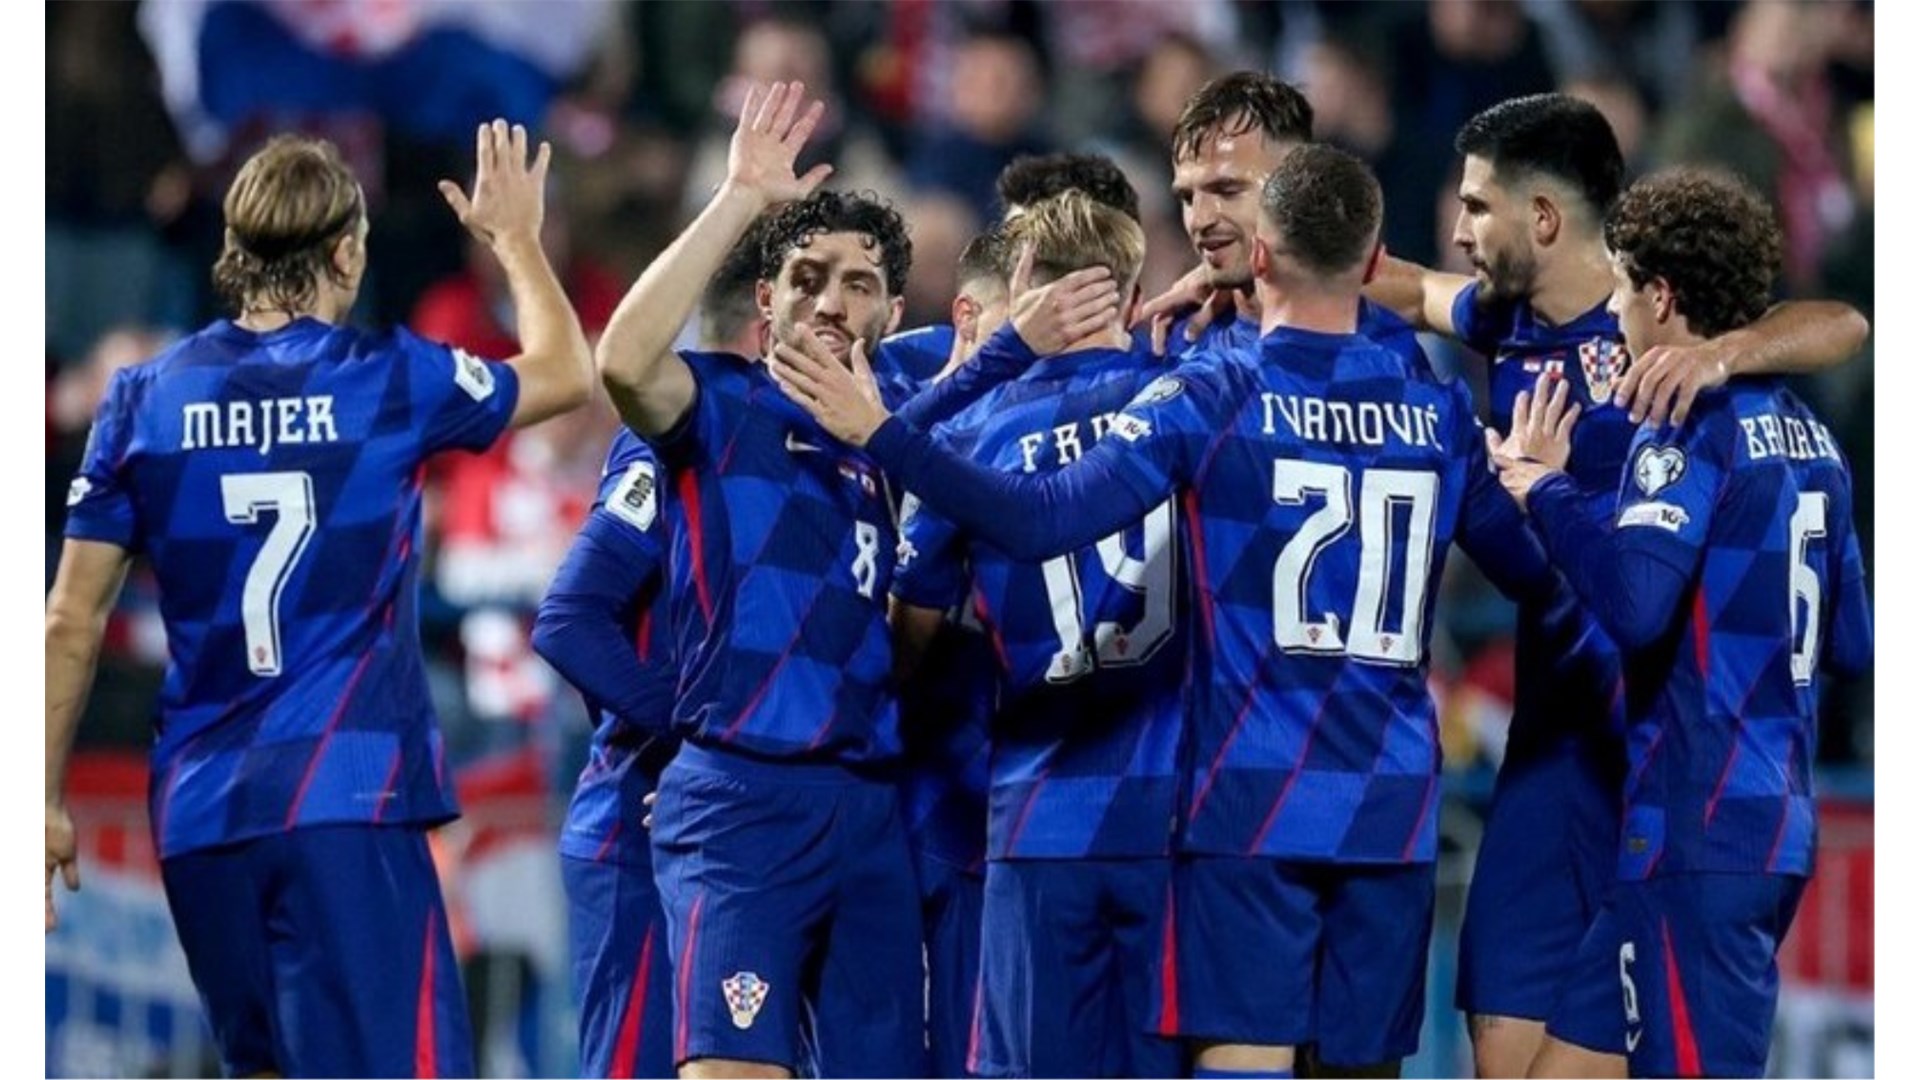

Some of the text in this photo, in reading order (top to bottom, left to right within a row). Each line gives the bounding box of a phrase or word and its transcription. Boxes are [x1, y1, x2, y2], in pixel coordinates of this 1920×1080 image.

[181, 395, 338, 455] MAJER
[1260, 392, 1443, 452] IVANOVIĆ
[221, 471, 317, 676] 7
[851, 519, 879, 598] 8
[1040, 493, 1178, 684] 19
[1273, 458, 1440, 668] 20
[1789, 490, 1828, 686] 6
[1620, 942, 1640, 1024] 6
